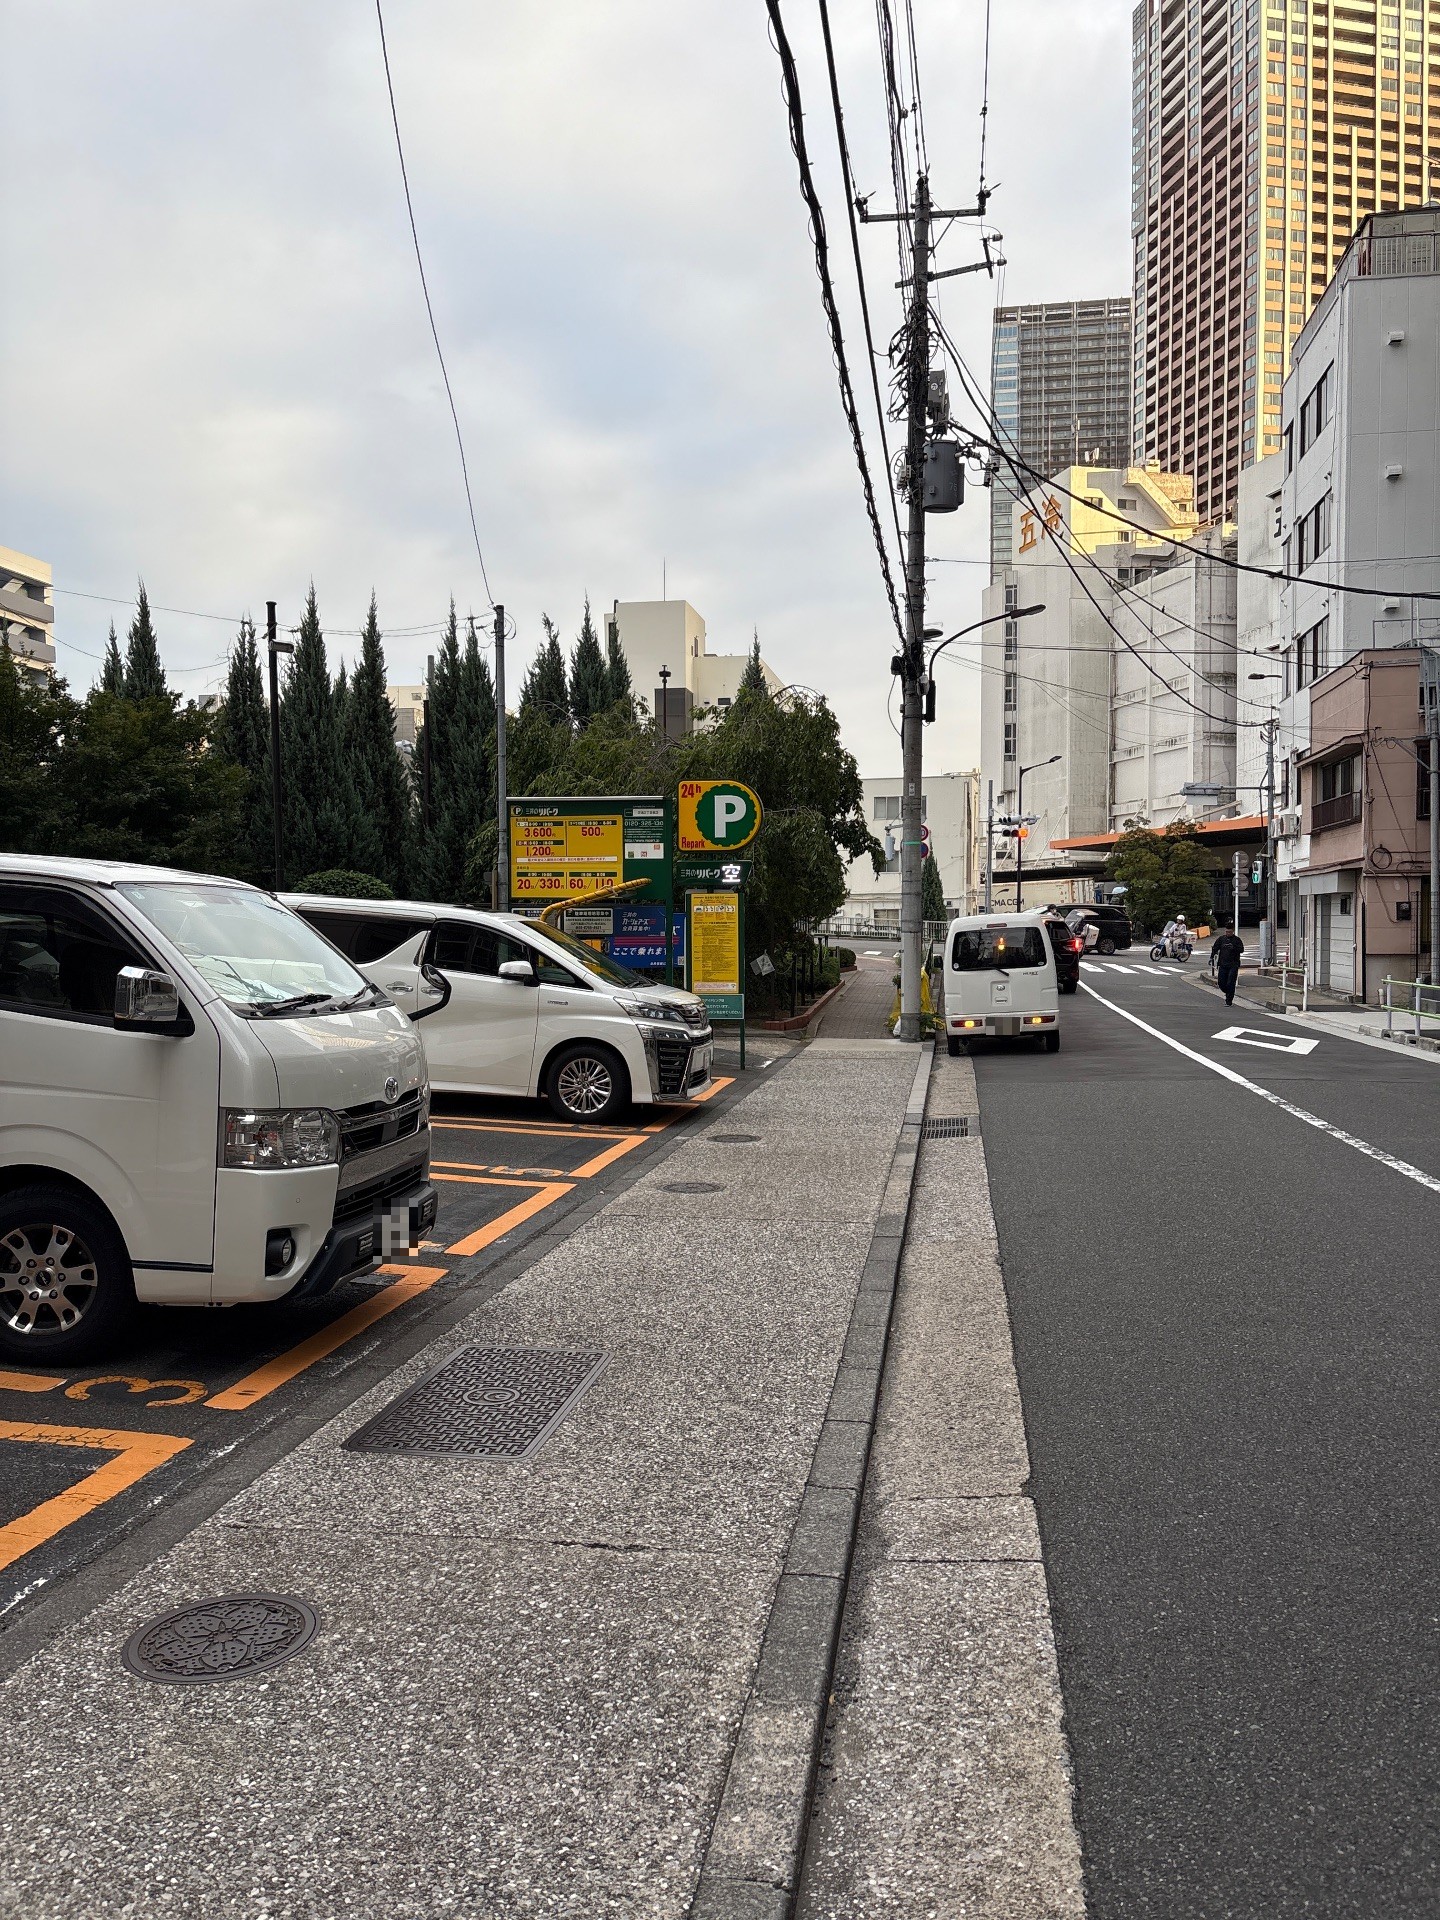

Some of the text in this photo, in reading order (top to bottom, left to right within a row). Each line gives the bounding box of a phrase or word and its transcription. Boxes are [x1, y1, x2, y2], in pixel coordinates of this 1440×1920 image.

[714, 795, 747, 838] P
[681, 837, 705, 849] Repark
[680, 869, 721, 879] 三井のリパーク
[721, 863, 741, 883] 空
[488, 1165, 565, 1178] 5
[64, 1375, 209, 1408] 3
